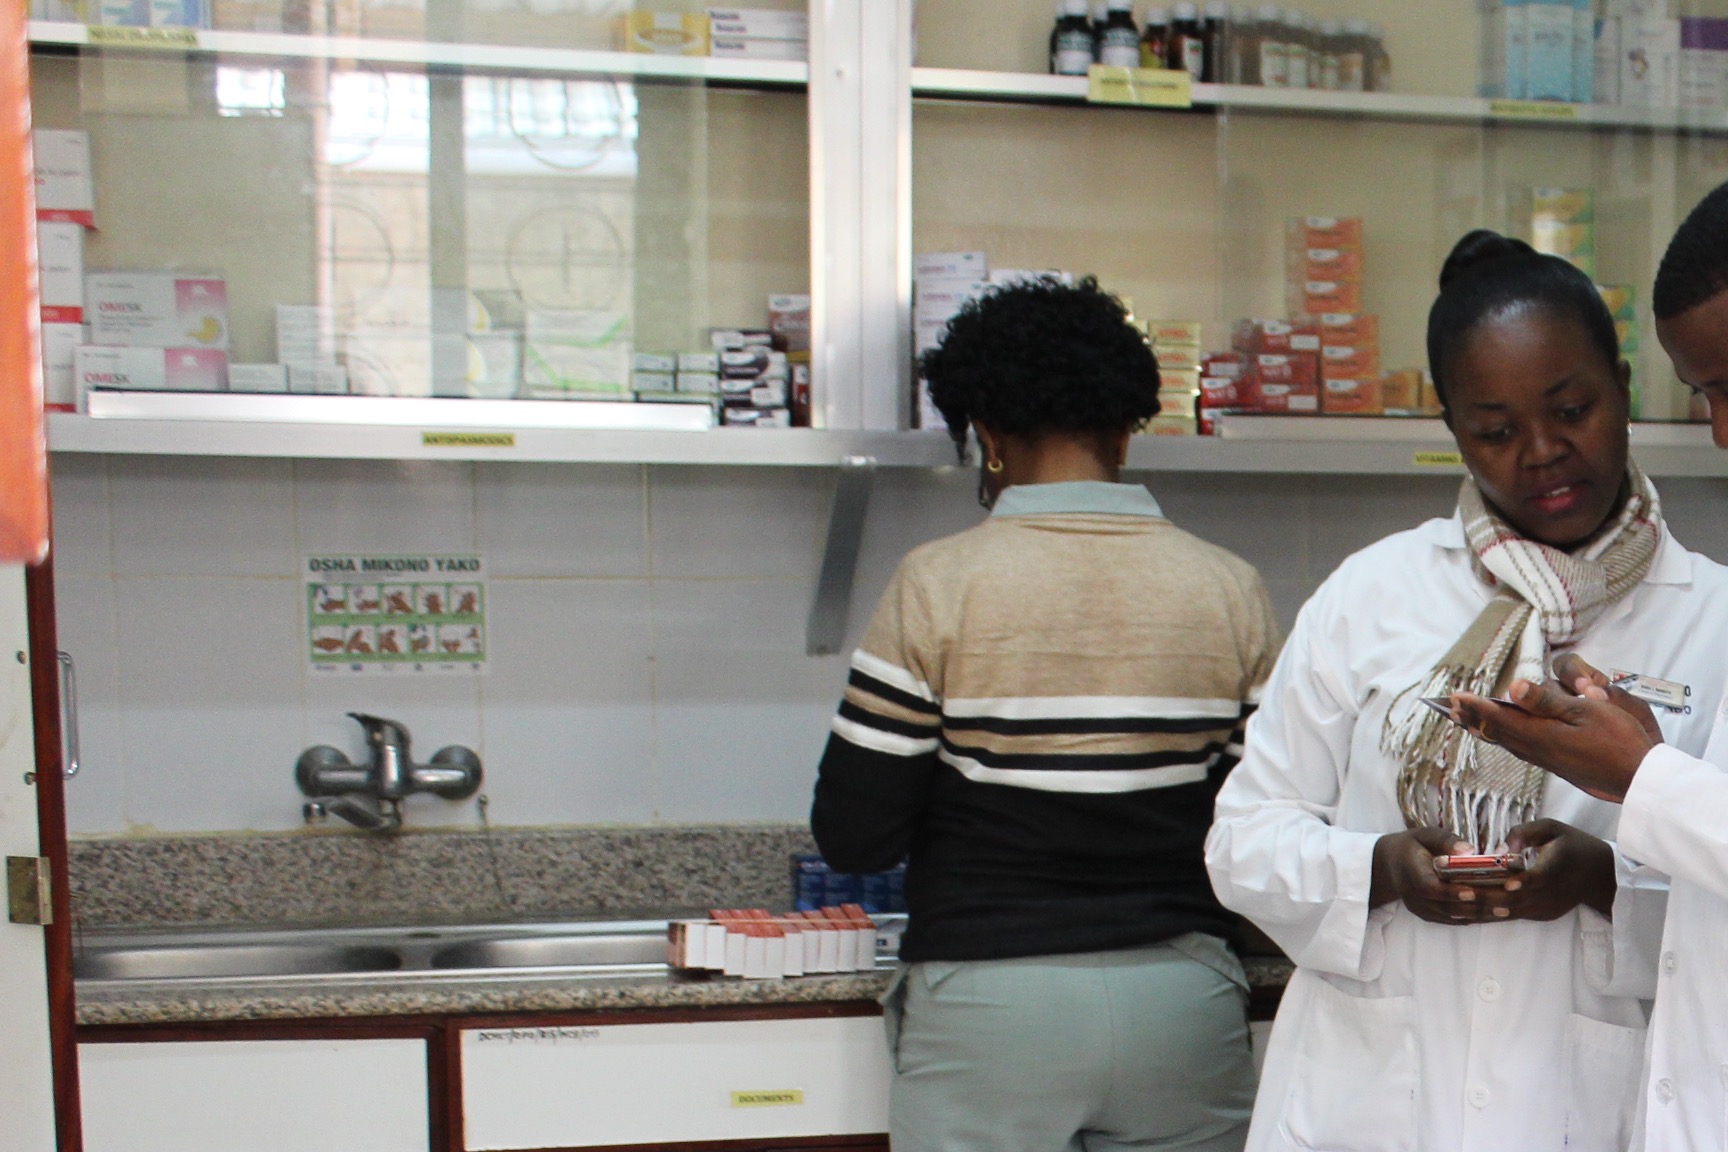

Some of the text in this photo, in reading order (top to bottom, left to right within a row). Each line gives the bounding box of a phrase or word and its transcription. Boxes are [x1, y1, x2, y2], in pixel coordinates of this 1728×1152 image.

[309, 558, 481, 572] OSHA MIKONO YAKO
